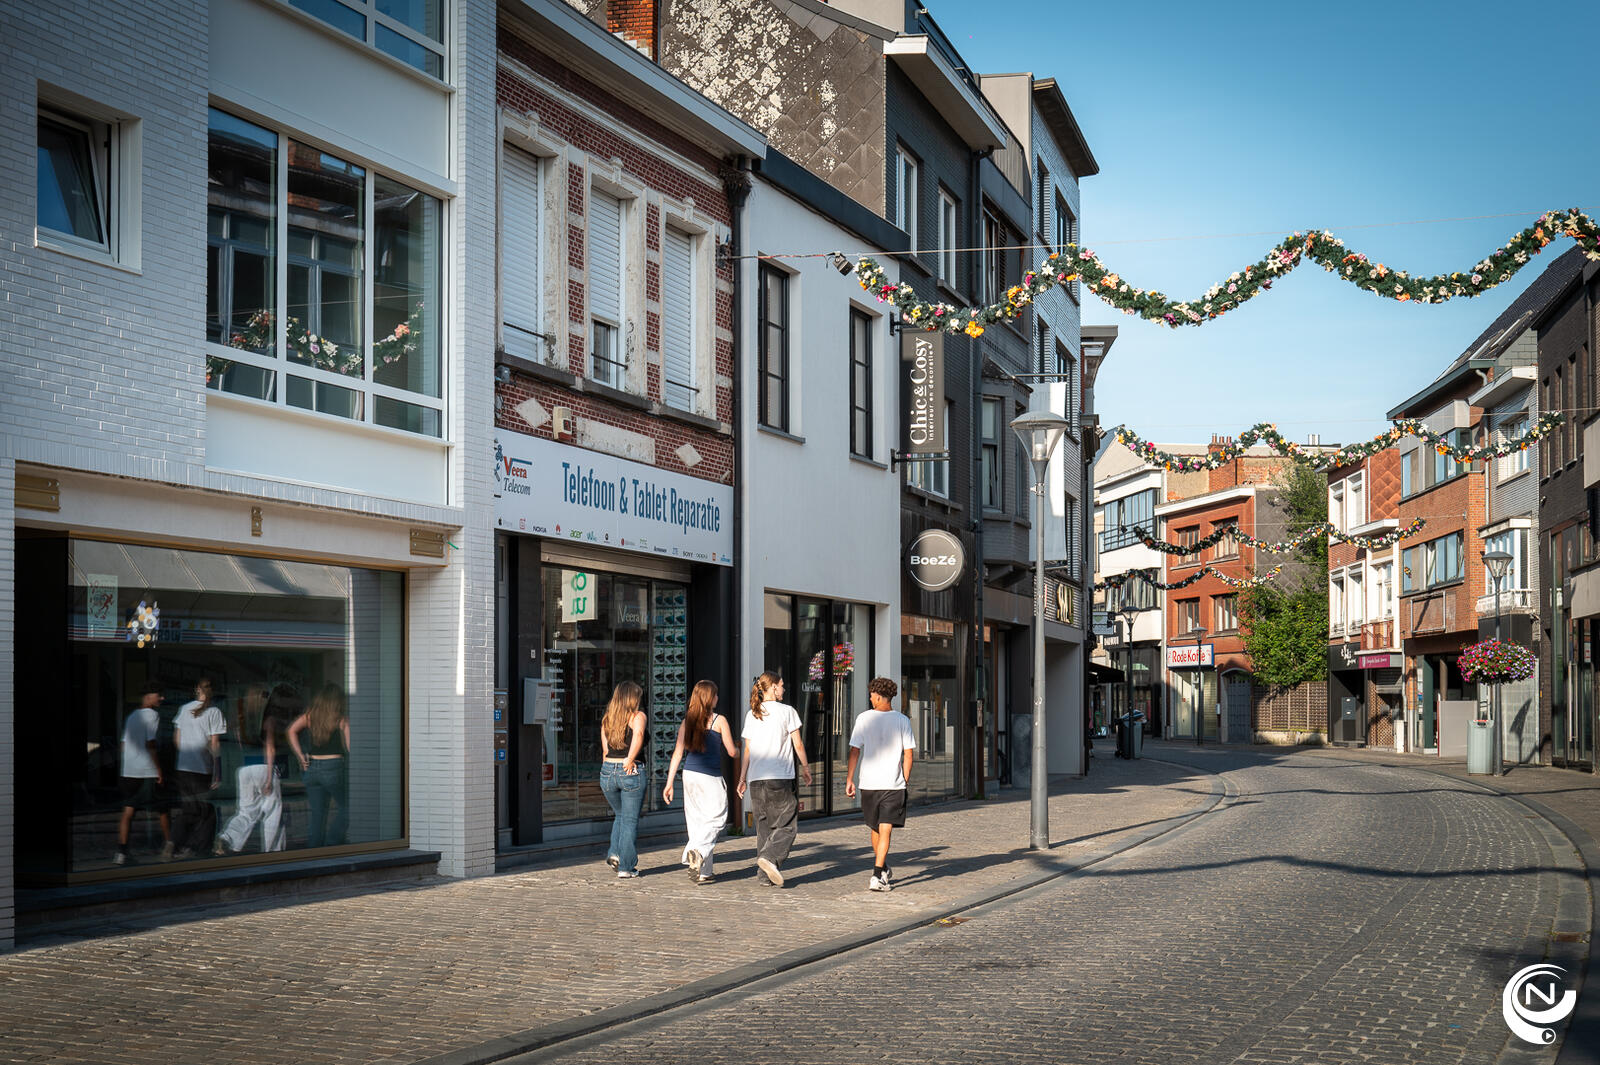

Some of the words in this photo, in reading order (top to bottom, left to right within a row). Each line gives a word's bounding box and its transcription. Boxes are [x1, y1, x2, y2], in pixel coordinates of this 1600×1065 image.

[909, 336, 933, 385] Cosy
[913, 385, 927, 397] &
[909, 398, 928, 445] Chic
[503, 456, 530, 479] Veera
[503, 477, 531, 496] Telecom
[562, 462, 615, 512] Telefoon
[619, 476, 628, 514] &
[632, 479, 667, 523] Tablet
[670, 488, 721, 536] Reparatie
[569, 529, 583, 539] acer
[910, 554, 957, 566] BoeZé
